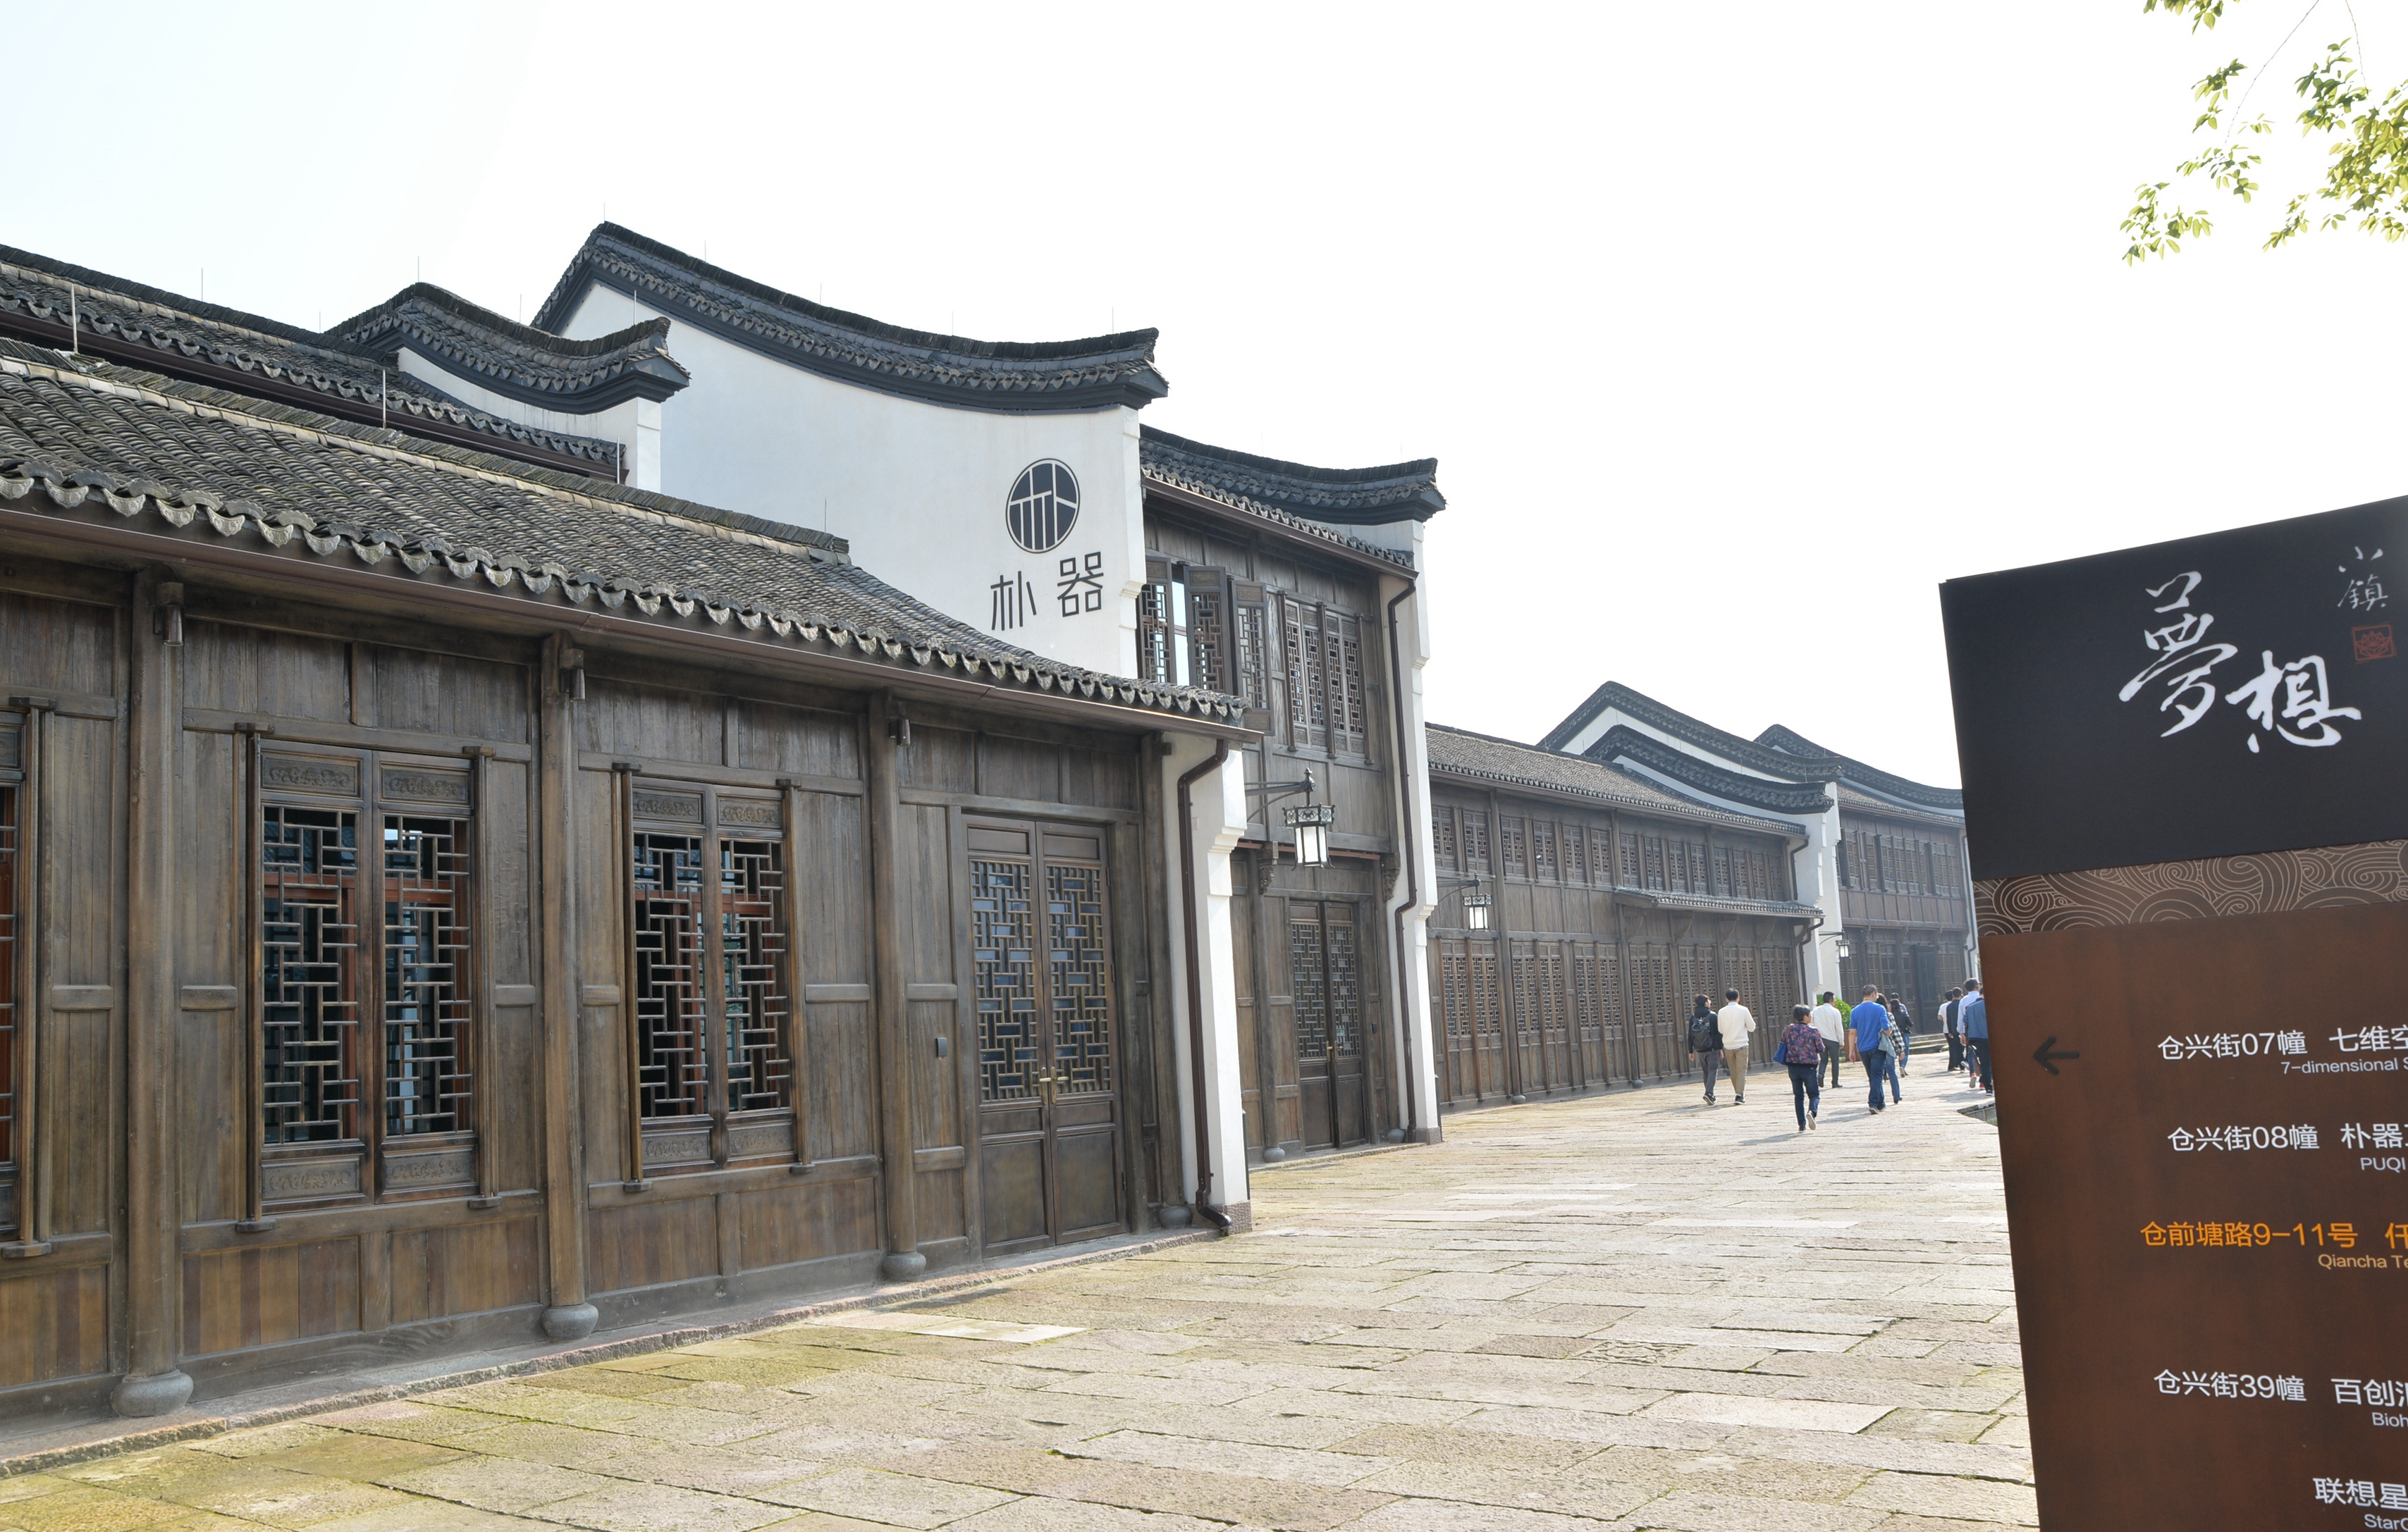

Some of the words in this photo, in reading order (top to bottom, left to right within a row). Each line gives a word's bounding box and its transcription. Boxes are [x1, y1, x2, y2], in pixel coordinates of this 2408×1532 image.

[990, 552, 1104, 631] 朴器
[2158, 1029, 2308, 1060] 仓兴街07幢
[2281, 1058, 2398, 1075] 7-dimensional
[2168, 1124, 2320, 1151] 仓兴街08幢
[2340, 1123, 2408, 1149] 朴器
[2360, 1157, 2406, 1173] PUQI
[2140, 1221, 2358, 1248] 仓前塘路9-11号
[2318, 1254, 2388, 1270] Qiancha
[2154, 1369, 2306, 1402] 仓兴街39幢
[2312, 1477, 2408, 1511] 联想星
